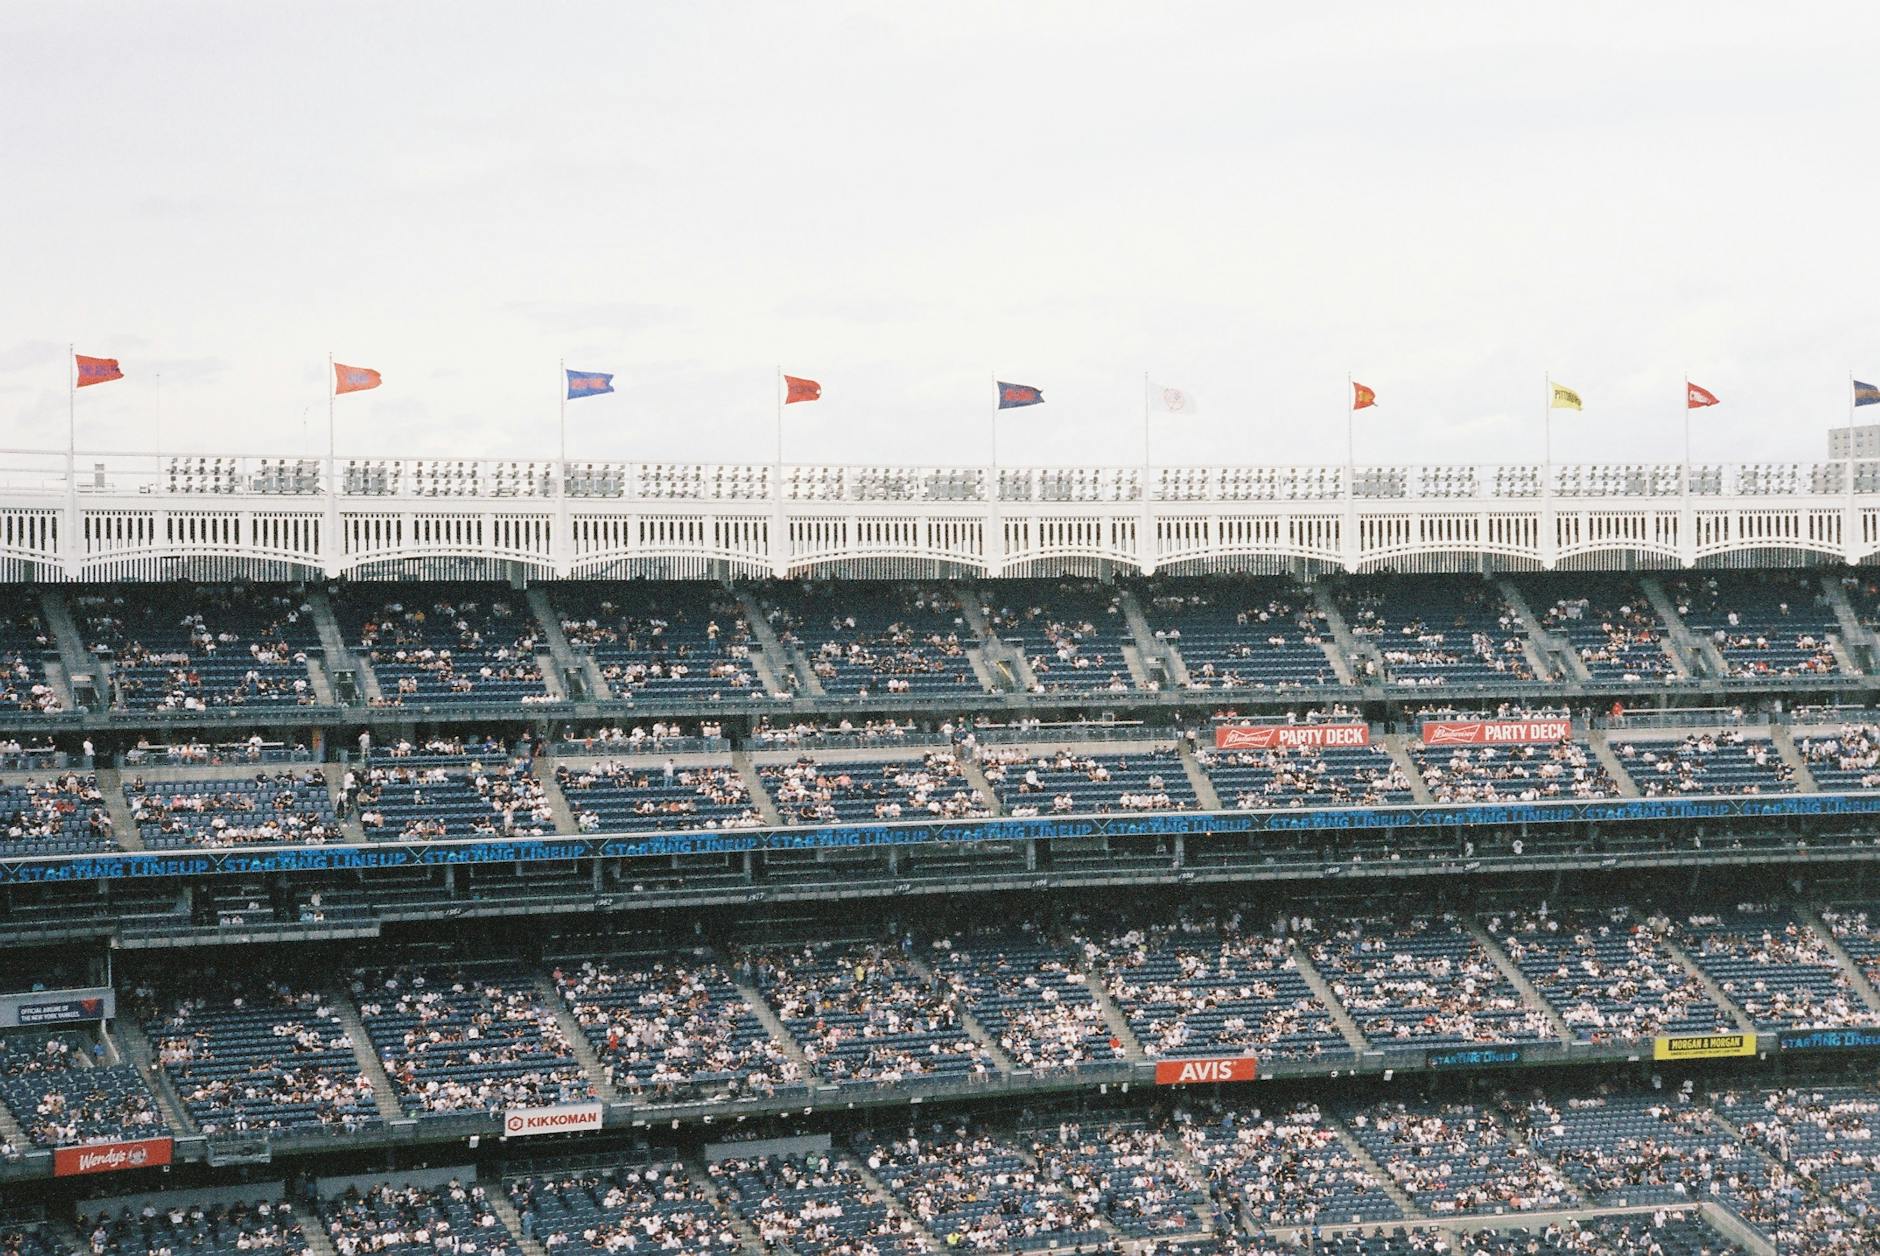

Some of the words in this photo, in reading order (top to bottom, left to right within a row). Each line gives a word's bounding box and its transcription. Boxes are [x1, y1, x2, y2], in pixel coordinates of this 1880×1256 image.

[1279, 729, 1323, 744] PARTY
[1326, 728, 1363, 743] DECK
[1485, 725, 1527, 740] PARTY
[1530, 723, 1566, 739] DECK
[1585, 806, 1667, 820] STARTING
[1672, 804, 1729, 818] LINEUP
[1743, 802, 1821, 815] STARTING
[1107, 820, 1188, 834] STARTING
[1194, 818, 1249, 832] LINEUP
[1270, 815, 1349, 830] STARTING
[1354, 814, 1410, 827] LINEUP
[1423, 812, 1507, 826] STARTING
[1512, 809, 1574, 822] LINEUP
[769, 833, 859, 848] STARTING
[866, 830, 928, 845] LINEUP
[942, 827, 1024, 841] STARTING
[1030, 823, 1092, 837] LINEUP
[424, 848, 514, 864] STARTING
[521, 845, 584, 861] LINEUP
[605, 840, 691, 855] STARTING
[697, 838, 757, 852] LINEUP
[19, 863, 123, 881] STARTING
[131, 860, 208, 875] LINEUP
[224, 856, 328, 872] STARTING
[334, 853, 407, 867] LINEUP
[21, 1007, 42, 1015] OFFICIAL
[1671, 1039, 1702, 1050] MORGAN
[1703, 1038, 1708, 1048] &
[1710, 1036, 1741, 1047] MORGAN
[1179, 1061, 1233, 1081] AVIS
[527, 1113, 597, 1128] KIKKOMAN
[80, 1149, 126, 1170] Wendy's
